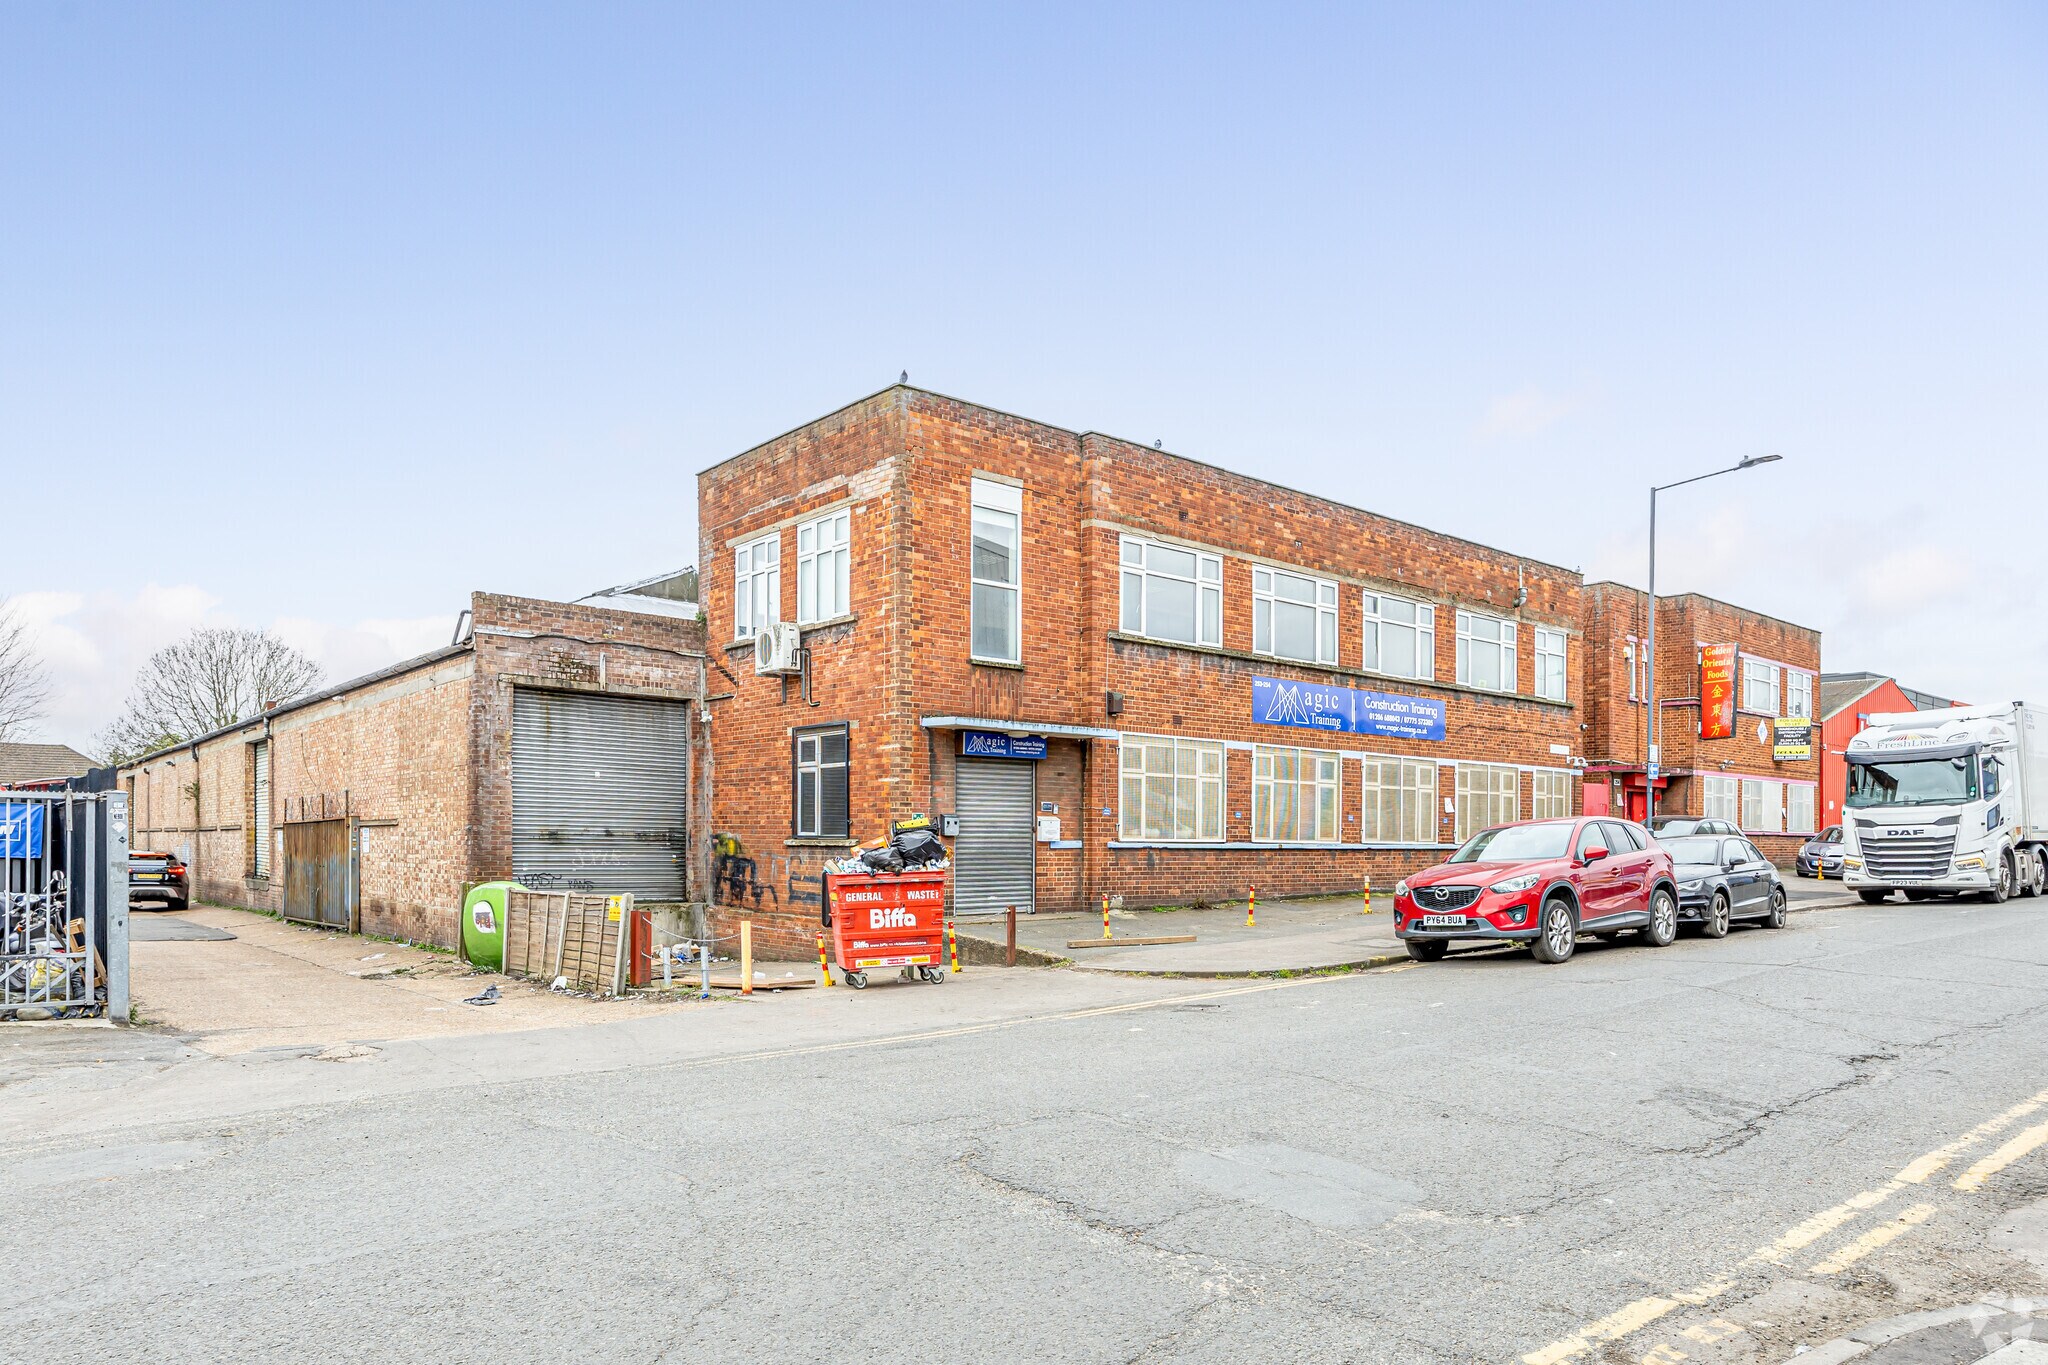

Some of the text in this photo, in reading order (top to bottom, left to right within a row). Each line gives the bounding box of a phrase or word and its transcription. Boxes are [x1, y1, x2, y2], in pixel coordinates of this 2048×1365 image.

[1705, 647, 1732, 656] Golden
[1702, 658, 1734, 668] Oriental
[1707, 670, 1729, 679] Foods
[1364, 695, 1438, 719] Construction Training
[1711, 684, 1724, 737] 金東方
[1310, 712, 1341, 729] Training
[1375, 724, 1428, 735] www.magic-training.co.uk
[1877, 740, 1939, 749] FreshLine
[989, 747, 1007, 755] Training
[845, 890, 934, 902] GENERAL WASTE
[869, 907, 917, 929] Biffa
[1426, 916, 1463, 924] PY64 BUA
[853, 940, 869, 949] Biffa
